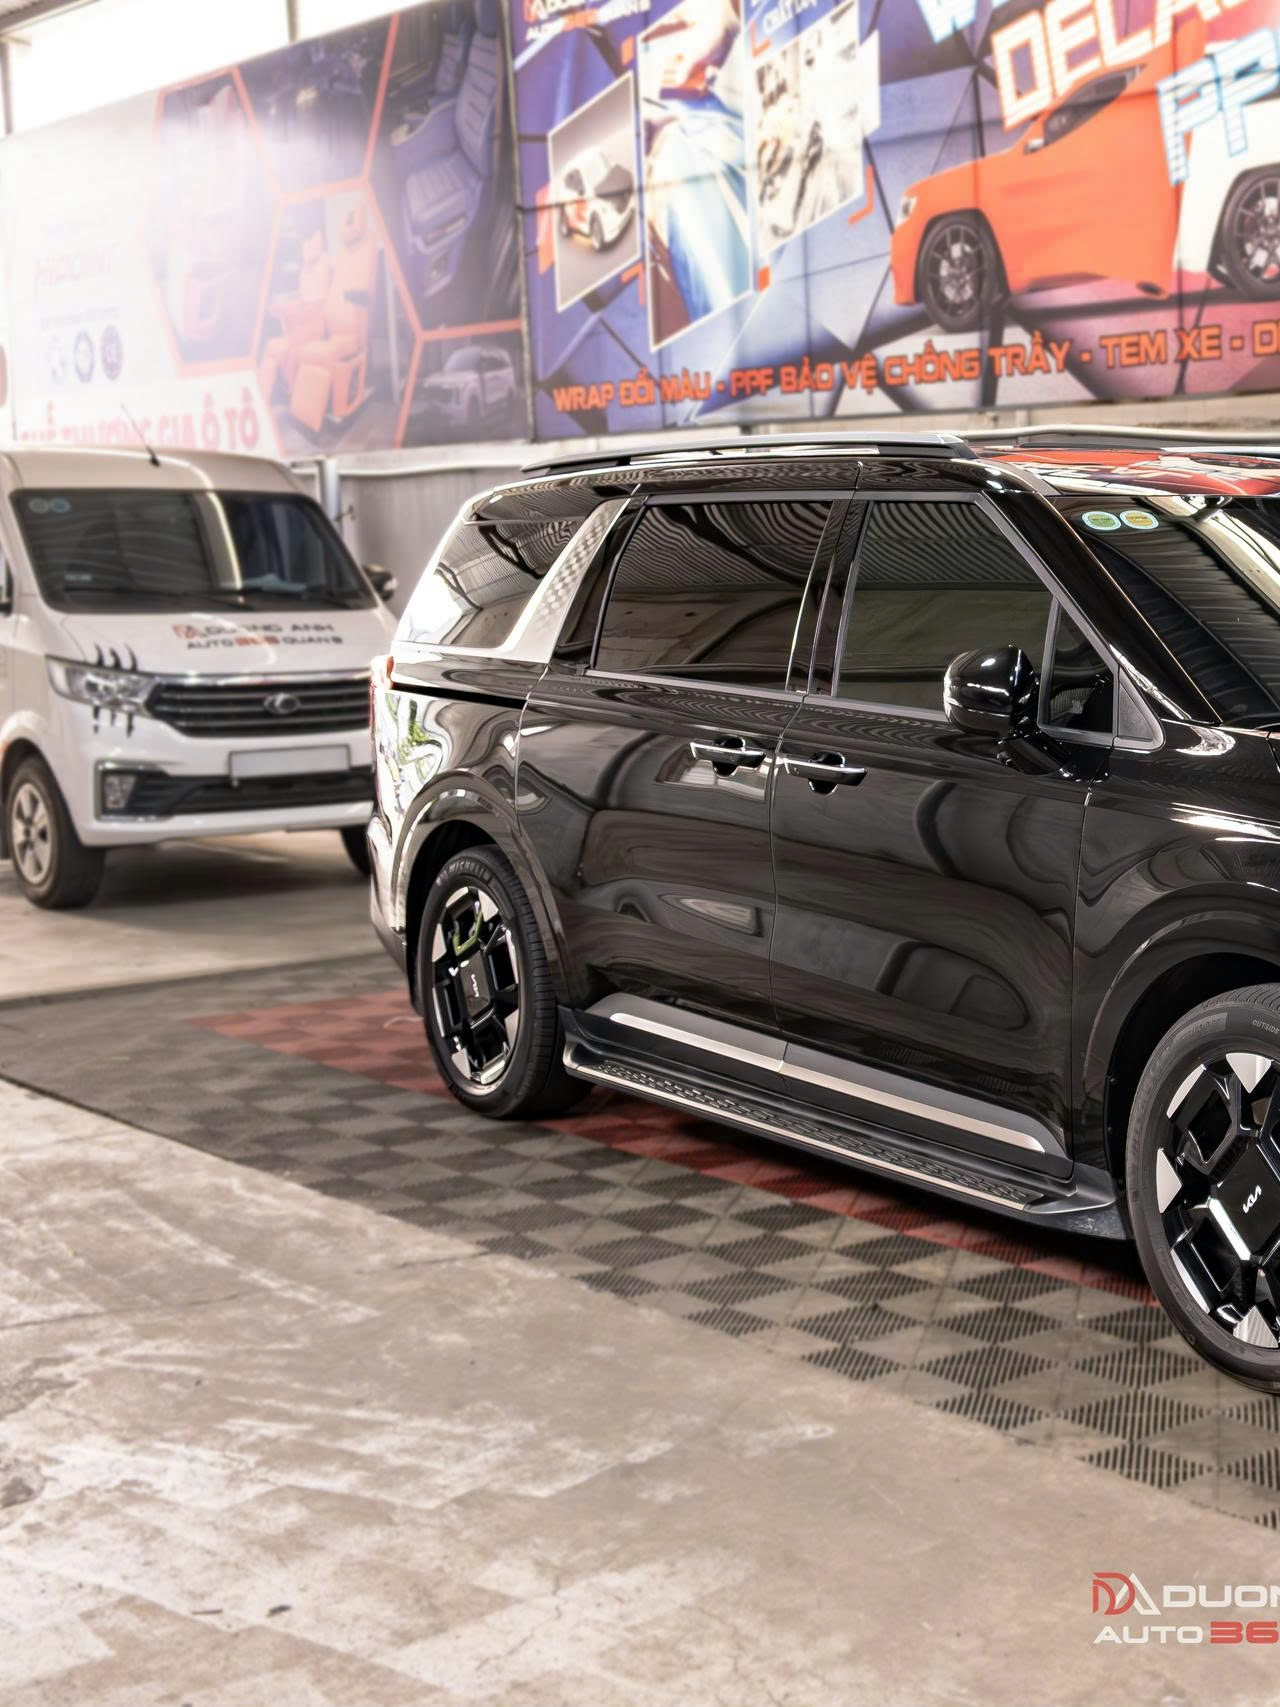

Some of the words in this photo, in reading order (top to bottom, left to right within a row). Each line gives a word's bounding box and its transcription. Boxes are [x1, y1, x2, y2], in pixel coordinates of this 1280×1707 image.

[553, 384, 614, 413] WRAP
[618, 364, 656, 407] ĐỔI
[658, 367, 712, 403] MÀU
[730, 367, 774, 397] PPF
[779, 356, 835, 394] BẢO
[838, 352, 877, 394] VỆ
[883, 340, 981, 386] CHỐNG
[1100, 329, 1168, 369] TEM
[1175, 325, 1223, 362] XE
[1252, 1018, 1280, 1035] OUTSIDE
